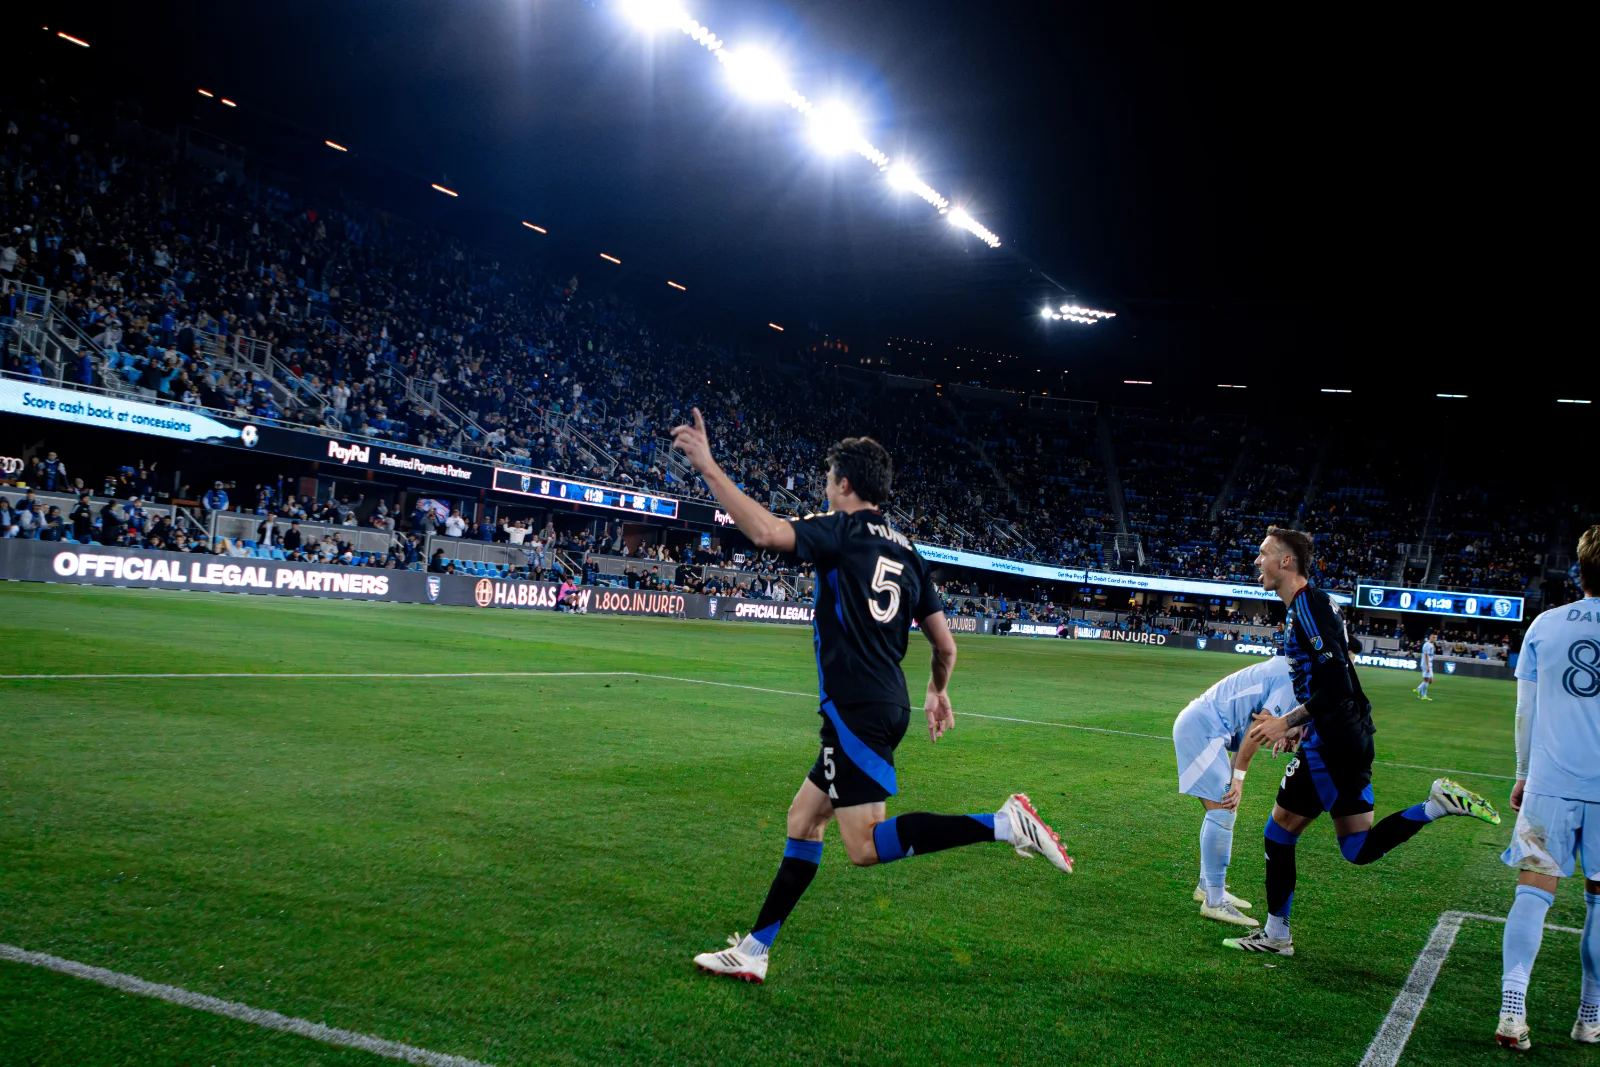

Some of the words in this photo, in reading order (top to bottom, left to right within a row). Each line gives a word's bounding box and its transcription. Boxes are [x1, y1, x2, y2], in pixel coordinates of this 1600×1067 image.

[23, 392, 56, 411] Score
[58, 400, 85, 416] cash
[87, 402, 113, 421] back
[117, 410, 129, 423] at
[131, 413, 192, 433] concessions
[328, 440, 370, 465] PayPal
[379, 452, 414, 471] Preferred
[413, 457, 447, 476] Payments
[447, 464, 472, 480] Partner
[560, 484, 567, 498] 0
[619, 494, 626, 508] 0
[53, 551, 188, 583] OFFICIAL
[190, 561, 273, 589] LEGAL
[275, 568, 389, 596] PARTNERS
[494, 582, 557, 607] HABBAS
[868, 555, 905, 623] 5
[1400, 592, 1411, 608] 0
[595, 591, 685, 614] 1.800.INJURED
[735, 602, 780, 619] OFFICIAL
[780, 606, 812, 621] LEGAL
[1465, 597, 1477, 614] 0
[1353, 654, 1417, 670] ARTNERS
[1562, 638, 1600, 698] 8
[823, 747, 836, 781] 5
